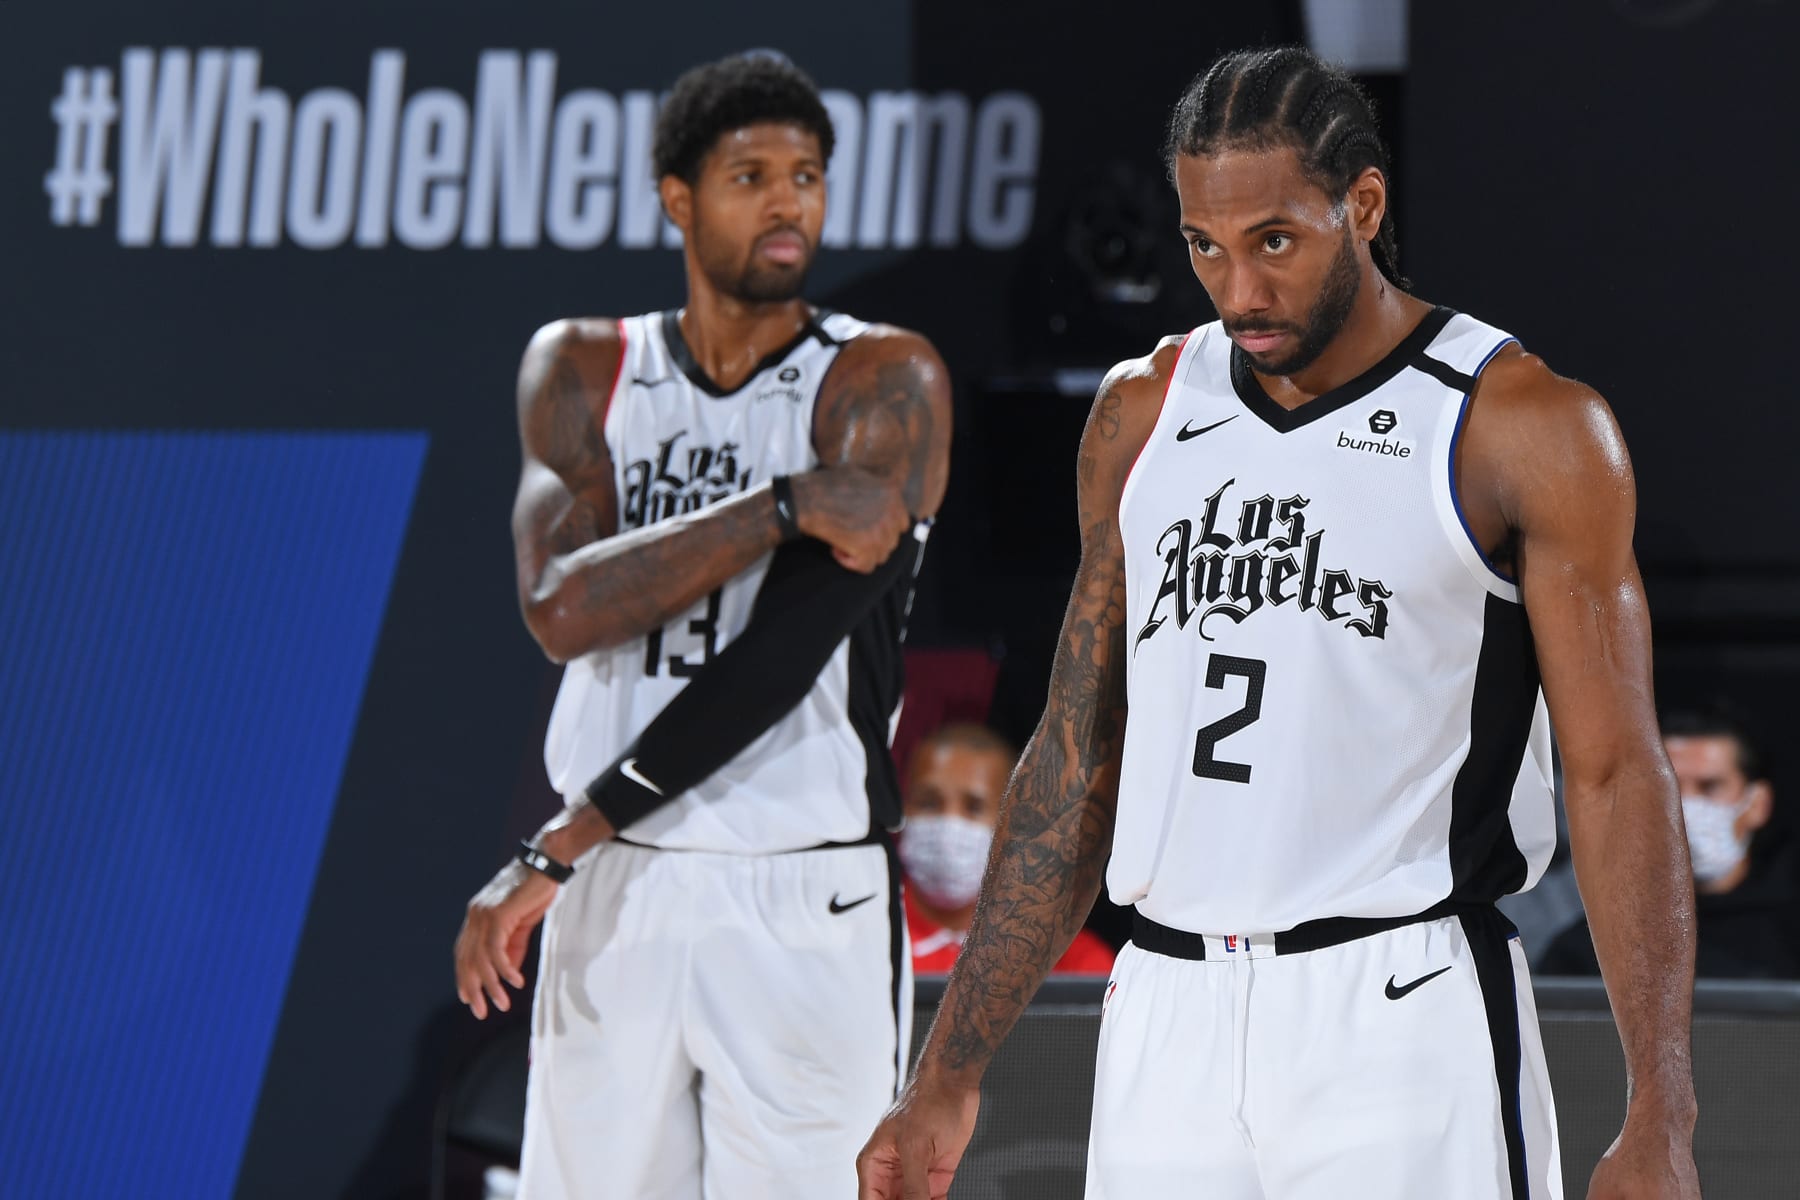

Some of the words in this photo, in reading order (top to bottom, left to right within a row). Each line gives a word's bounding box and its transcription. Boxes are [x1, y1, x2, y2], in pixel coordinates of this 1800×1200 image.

[44, 47, 1042, 250] #WholeNewame
[1336, 430, 1411, 458] bumble
[1191, 478, 1310, 552] Los
[1134, 518, 1393, 659] Angeles
[1192, 653, 1267, 784] 2
